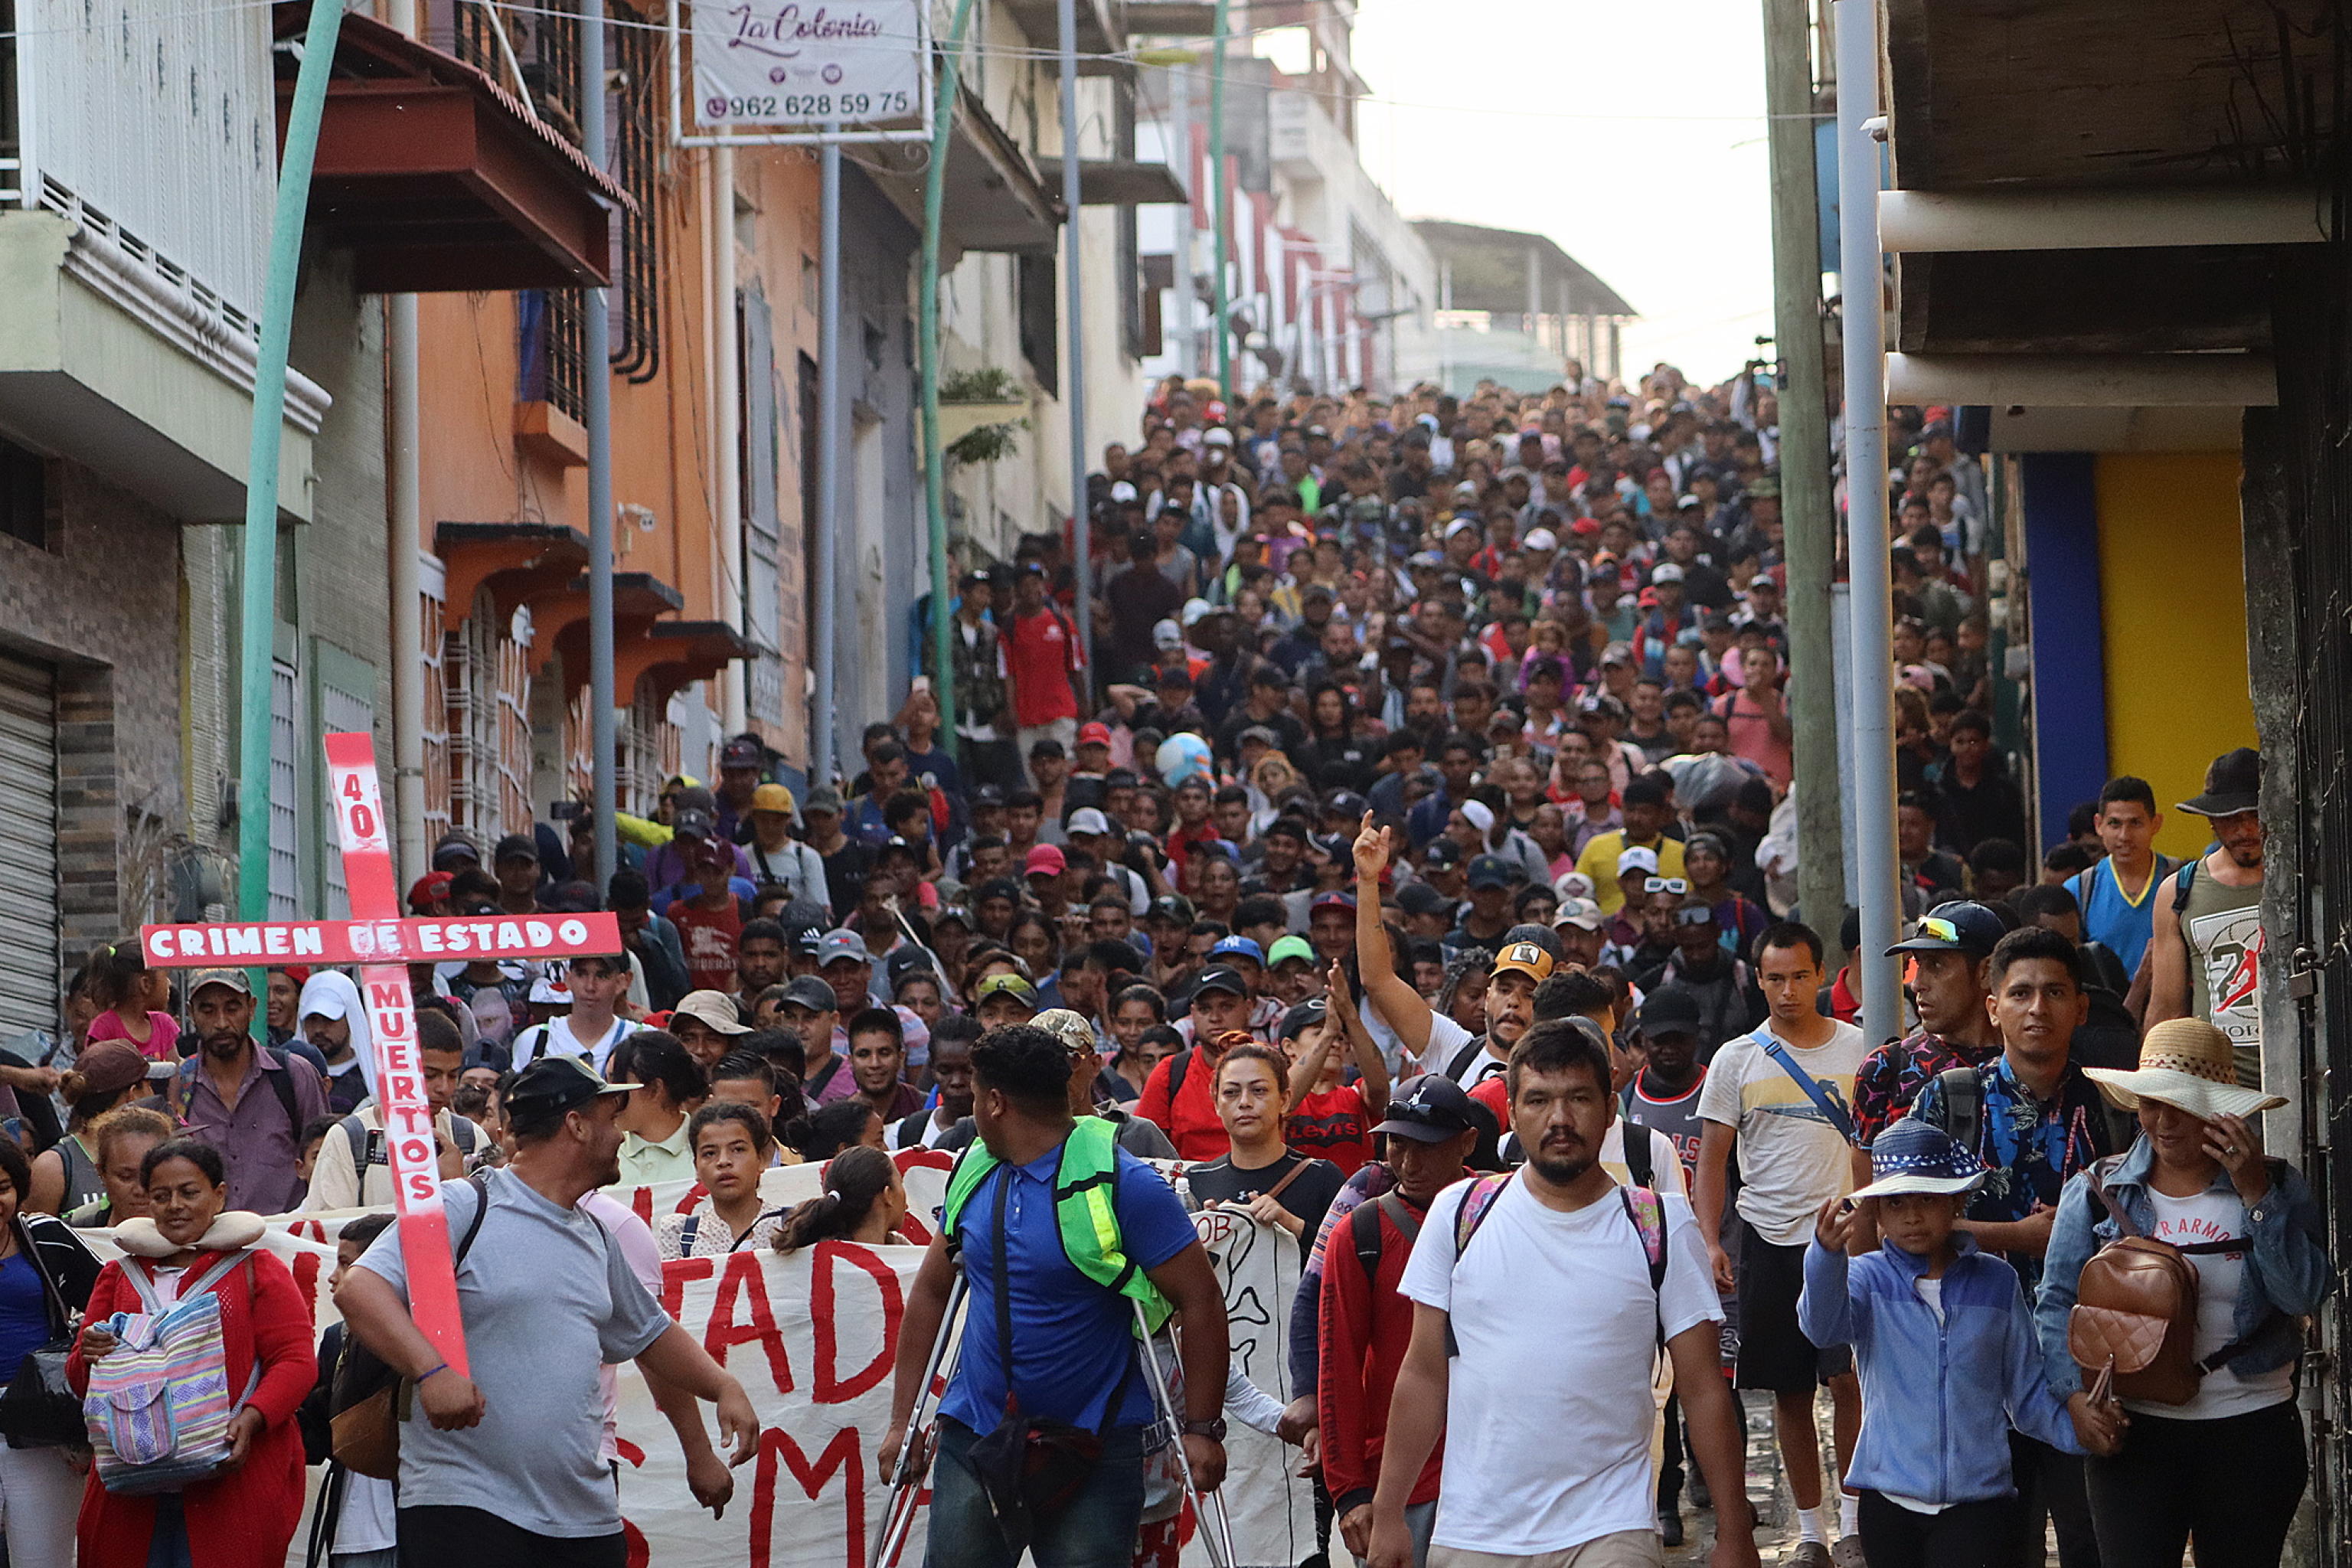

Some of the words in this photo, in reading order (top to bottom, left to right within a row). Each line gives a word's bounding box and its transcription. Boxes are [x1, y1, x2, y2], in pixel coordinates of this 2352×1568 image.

[774, 3, 881, 40] Colonia
[730, 96, 776, 116] 962
[786, 94, 831, 116] 628
[841, 93, 869, 114] 59
[880, 90, 907, 113] 75
[149, 926, 323, 957] CRIMEN
[348, 923, 400, 954] DE
[418, 919, 587, 952] ESTADO
[371, 984, 434, 1200] MUERTOS
